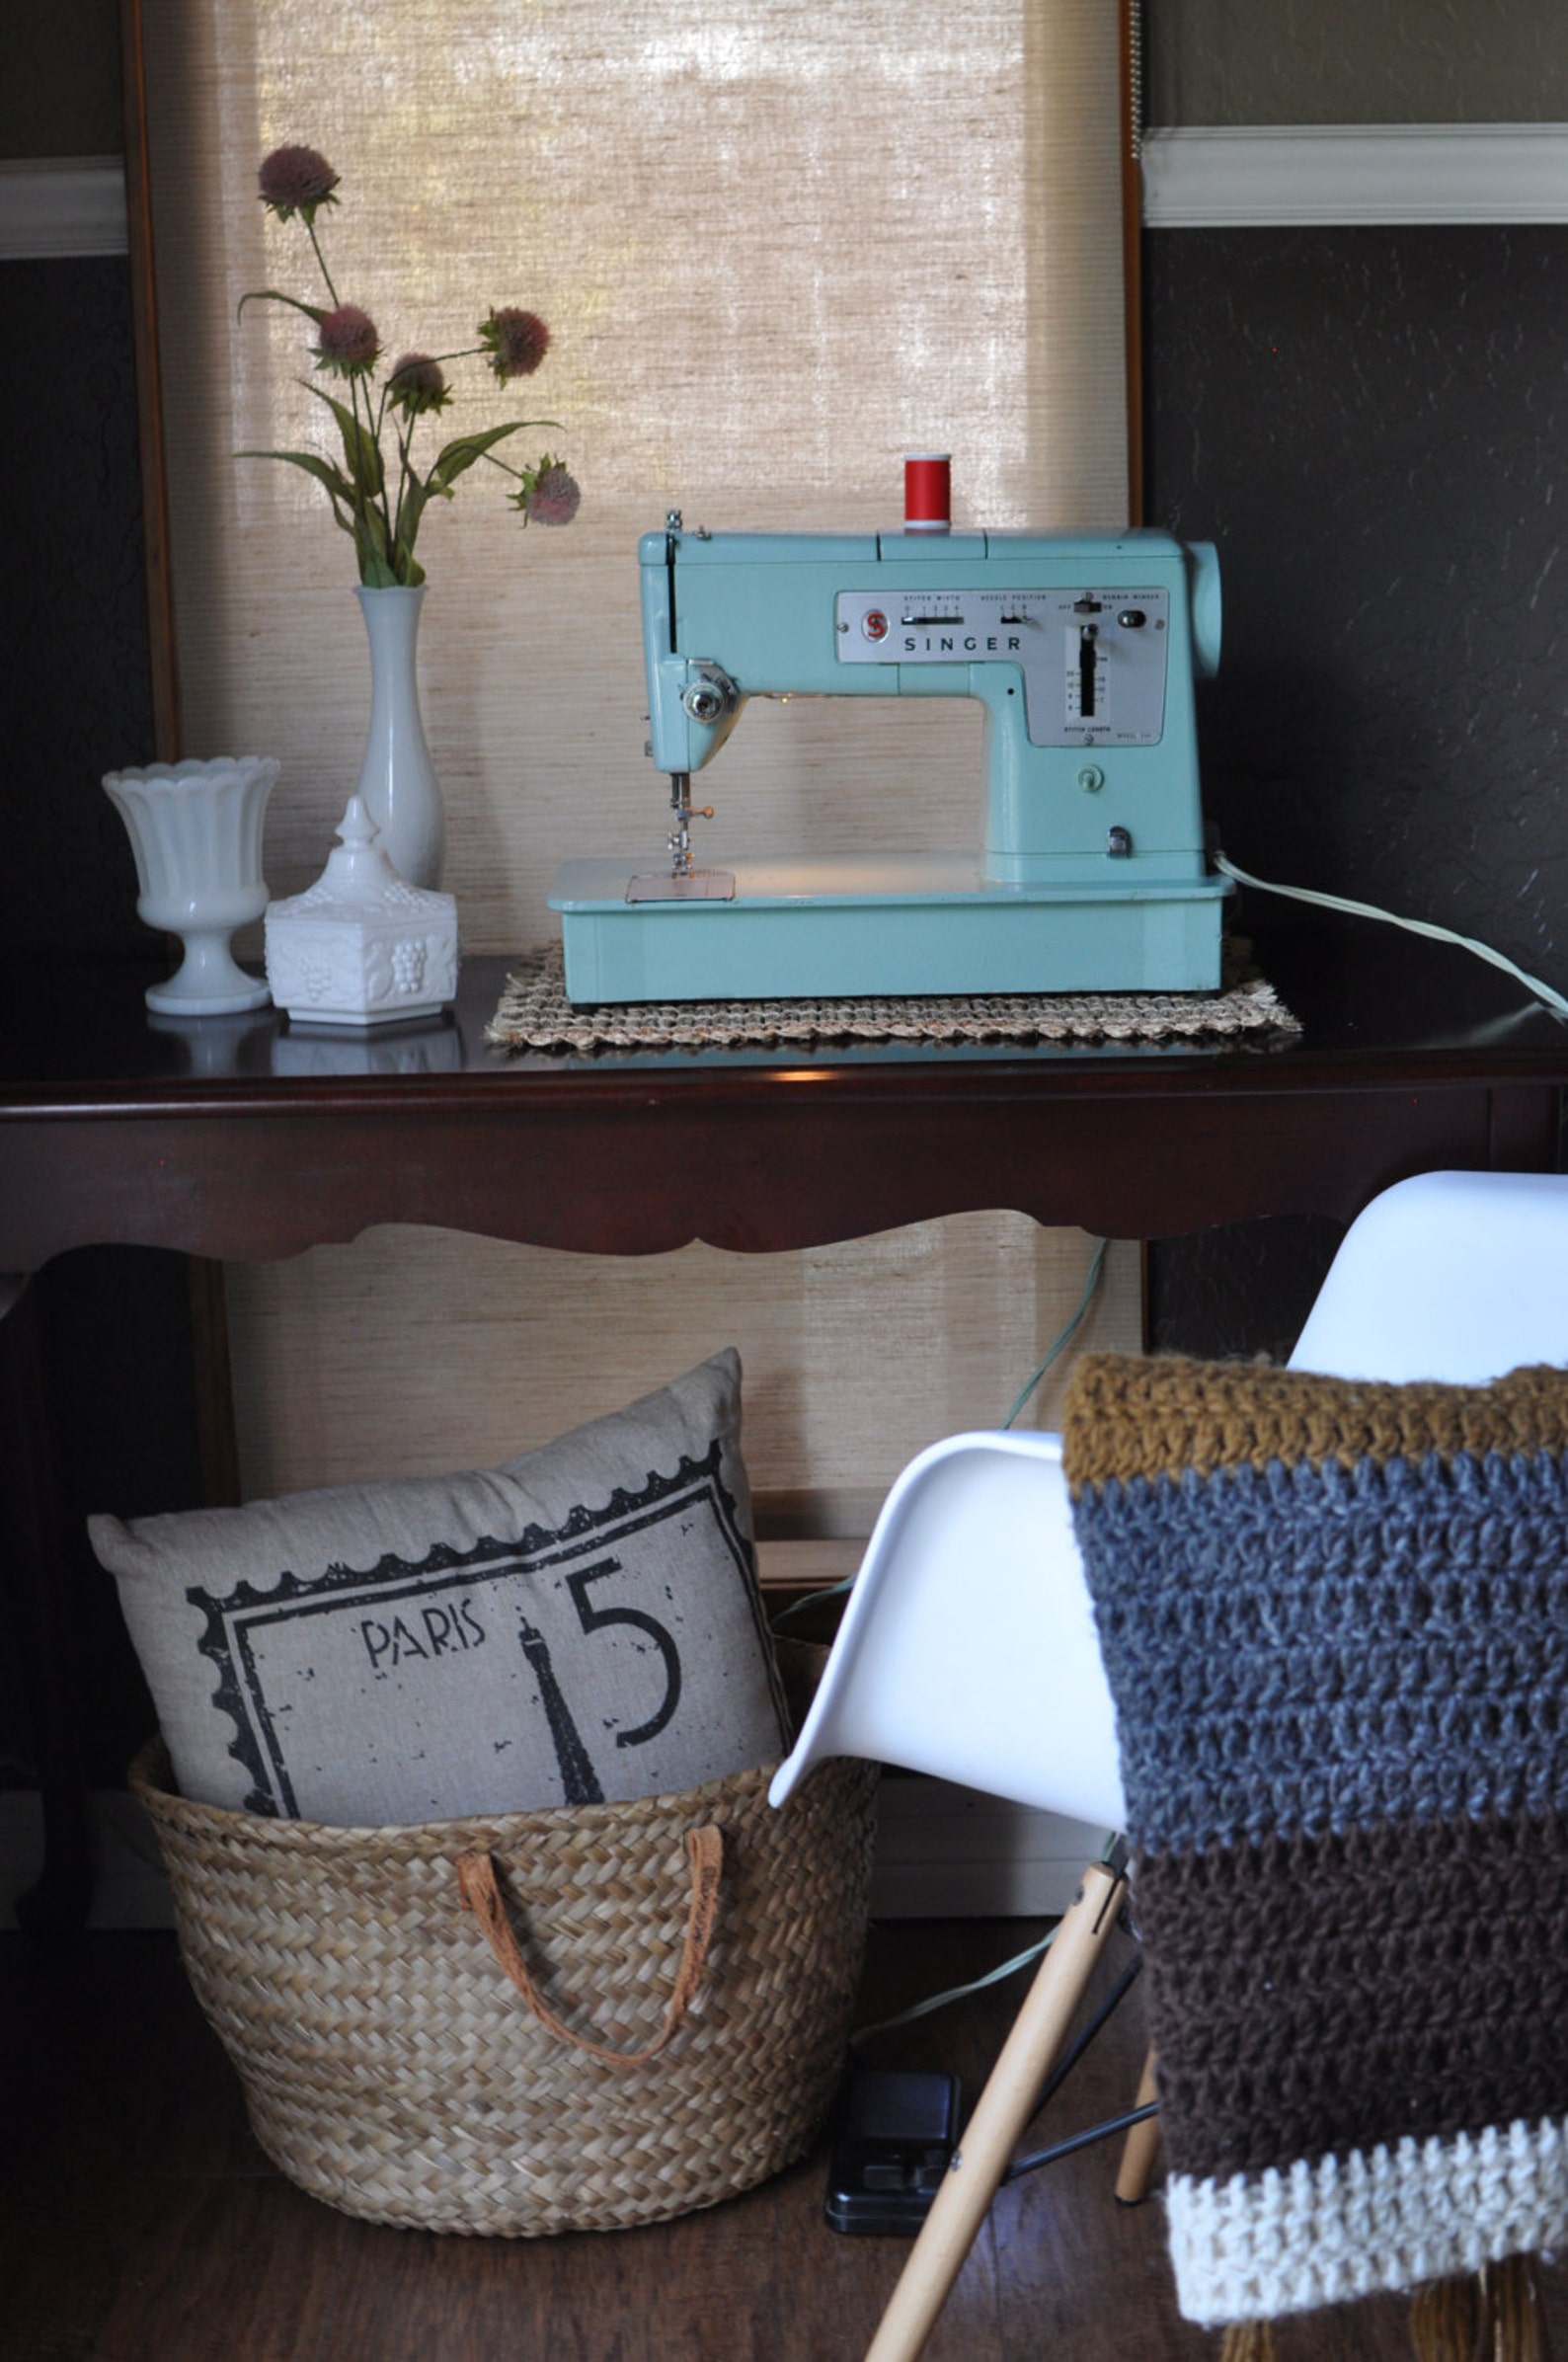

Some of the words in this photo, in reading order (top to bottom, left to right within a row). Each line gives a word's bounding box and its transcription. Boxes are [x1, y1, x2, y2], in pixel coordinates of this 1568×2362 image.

[867, 612, 886, 638] S
[904, 637, 1021, 651] SINGER
[361, 1599, 486, 1669] PARIS
[564, 1557, 682, 1750] 5
